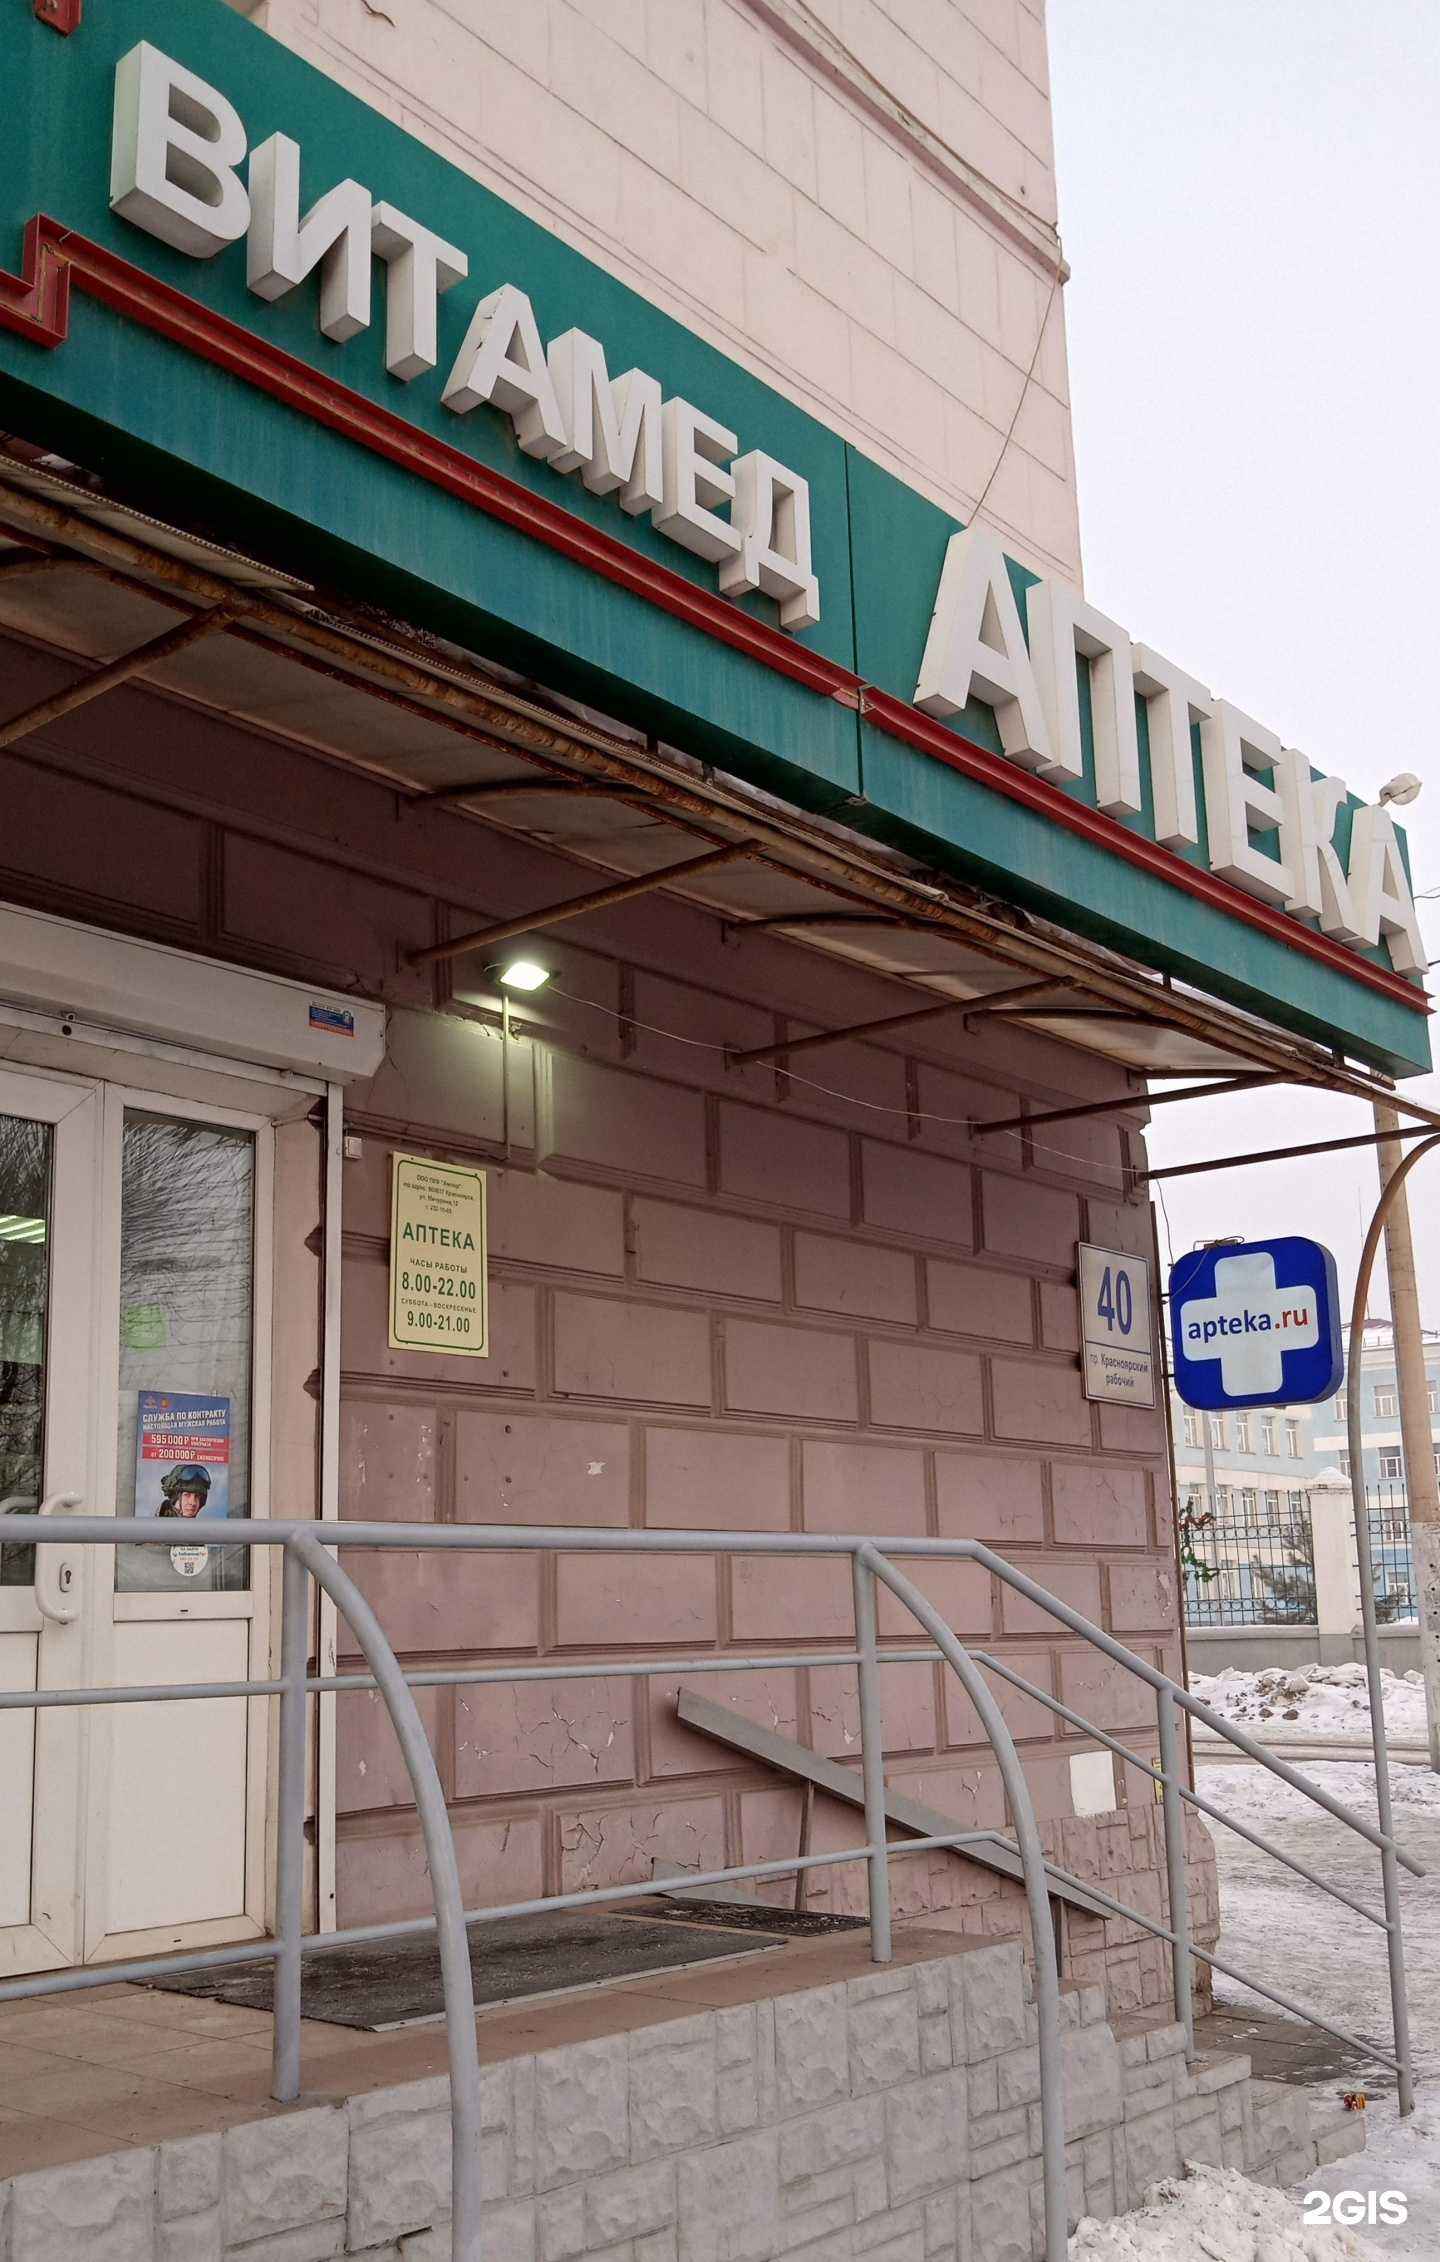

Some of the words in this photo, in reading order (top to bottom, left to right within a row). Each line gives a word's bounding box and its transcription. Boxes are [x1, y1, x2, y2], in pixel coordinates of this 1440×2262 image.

[109, 40, 820, 630] ВИТАМЕД
[913, 526, 1429, 976] АПТЕКА
[402, 1221, 475, 1251] АПТЕКА
[410, 1257, 433, 1269] ЧАСЫ
[435, 1262, 468, 1274] РАБОТЫ
[402, 1271, 476, 1299] 8.00-22.00
[1097, 1266, 1132, 1335] 40
[407, 1310, 470, 1333] 9.00-21.00
[1188, 1308, 1309, 1343] apteka.ru
[1101, 1353, 1148, 1372] Красноярский
[1105, 1373, 1134, 1387] рабочий
[143, 1412, 175, 1422] СЛУЖБА
[176, 1411, 187, 1420] ПО
[188, 1409, 226, 1420] КОНТРАКТУ
